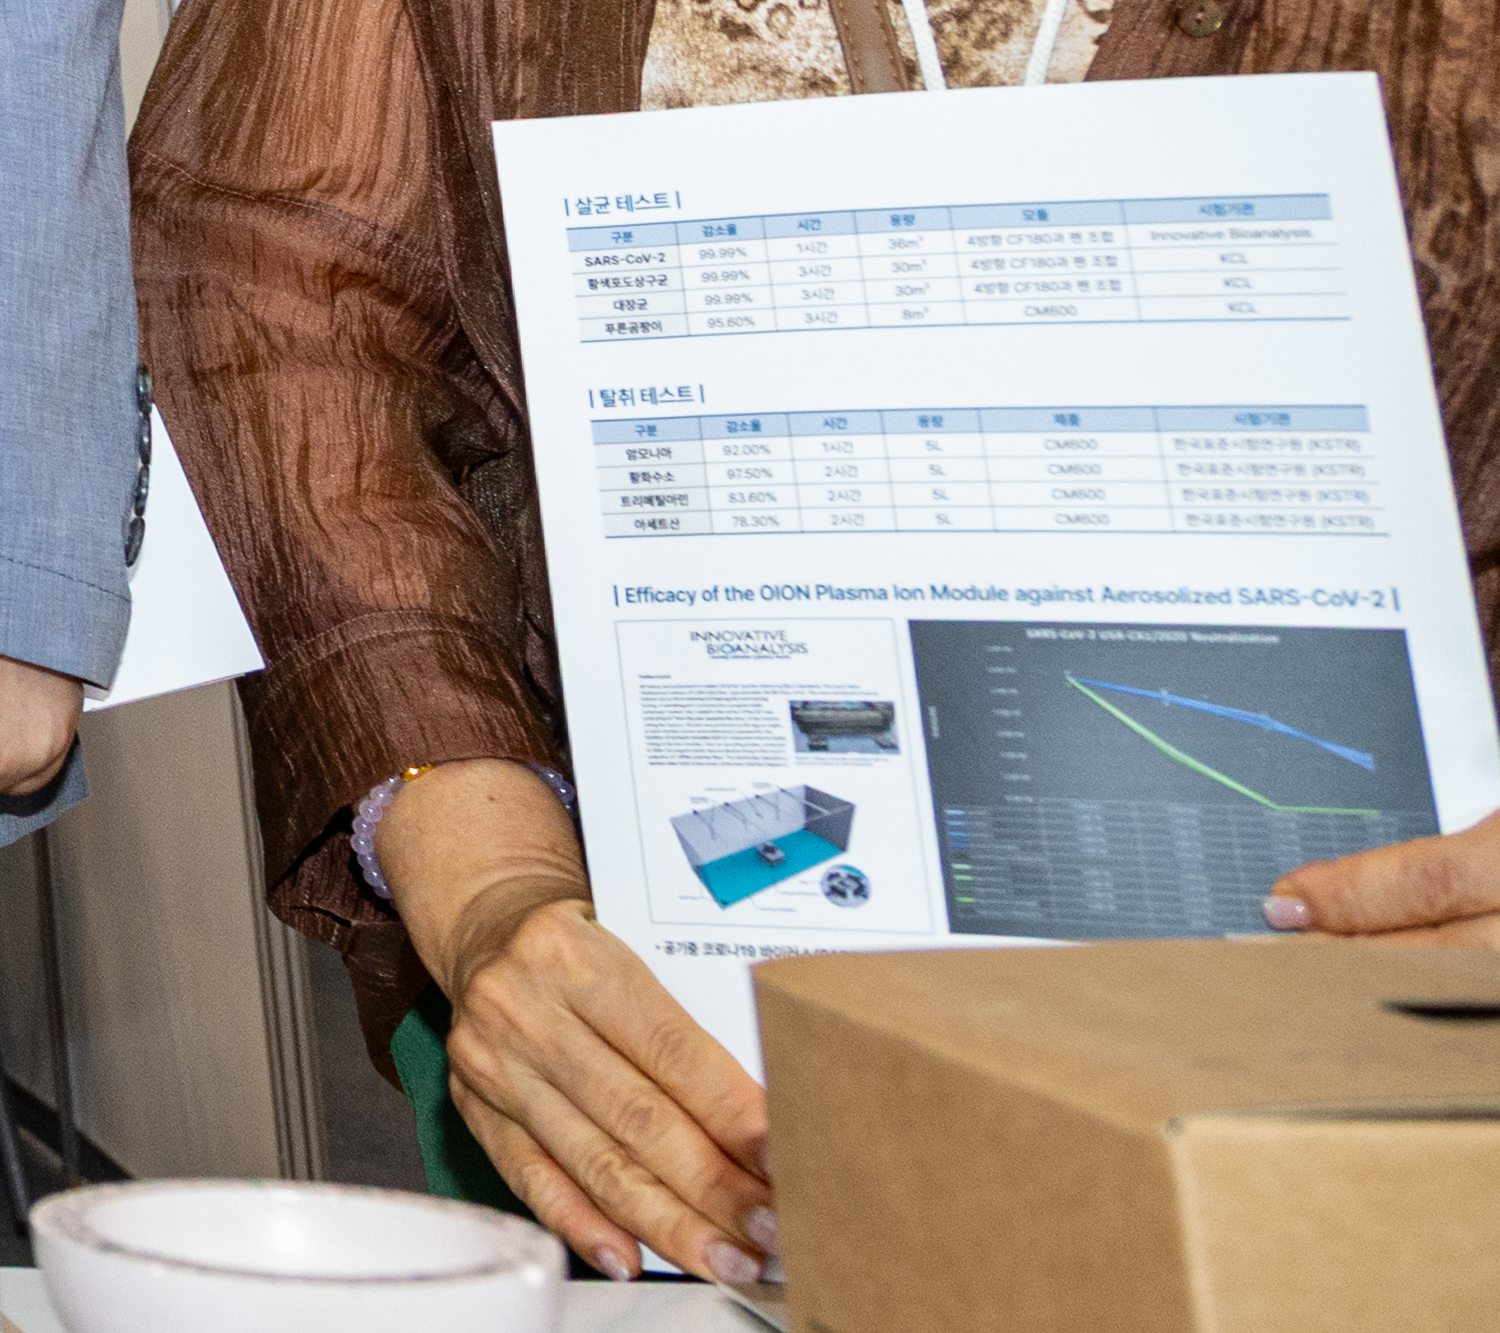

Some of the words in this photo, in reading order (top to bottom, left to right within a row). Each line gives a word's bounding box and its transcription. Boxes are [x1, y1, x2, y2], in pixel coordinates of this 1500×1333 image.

[574, 196, 611, 217] 살균
[616, 191, 671, 213] 테스트
[611, 229, 634, 244] 구분
[798, 217, 823, 232] 시간
[584, 251, 667, 269] SARS-CoV-2
[613, 297, 649, 312] 대장균
[599, 386, 637, 408] 탈취
[640, 384, 695, 406] 테스트
[635, 423, 658, 437] 구분
[823, 415, 849, 431] 시간
[625, 586, 697, 607] Efficacy
[701, 584, 719, 603] of
[722, 585, 756, 602] the
[760, 583, 811, 602] OION
[816, 583, 889, 602] Plasma
[893, 584, 926, 602] Ion
[930, 584, 1010, 602] Module
[1014, 585, 1095, 607] against
[1101, 585, 1233, 606] Aerosolized
[1237, 587, 1386, 609] SARS-CoV-2
[689, 630, 789, 643] INNOVATIVE
[706, 643, 810, 656] BIOANALYSIS
[664, 940, 699, 957] 공기중
